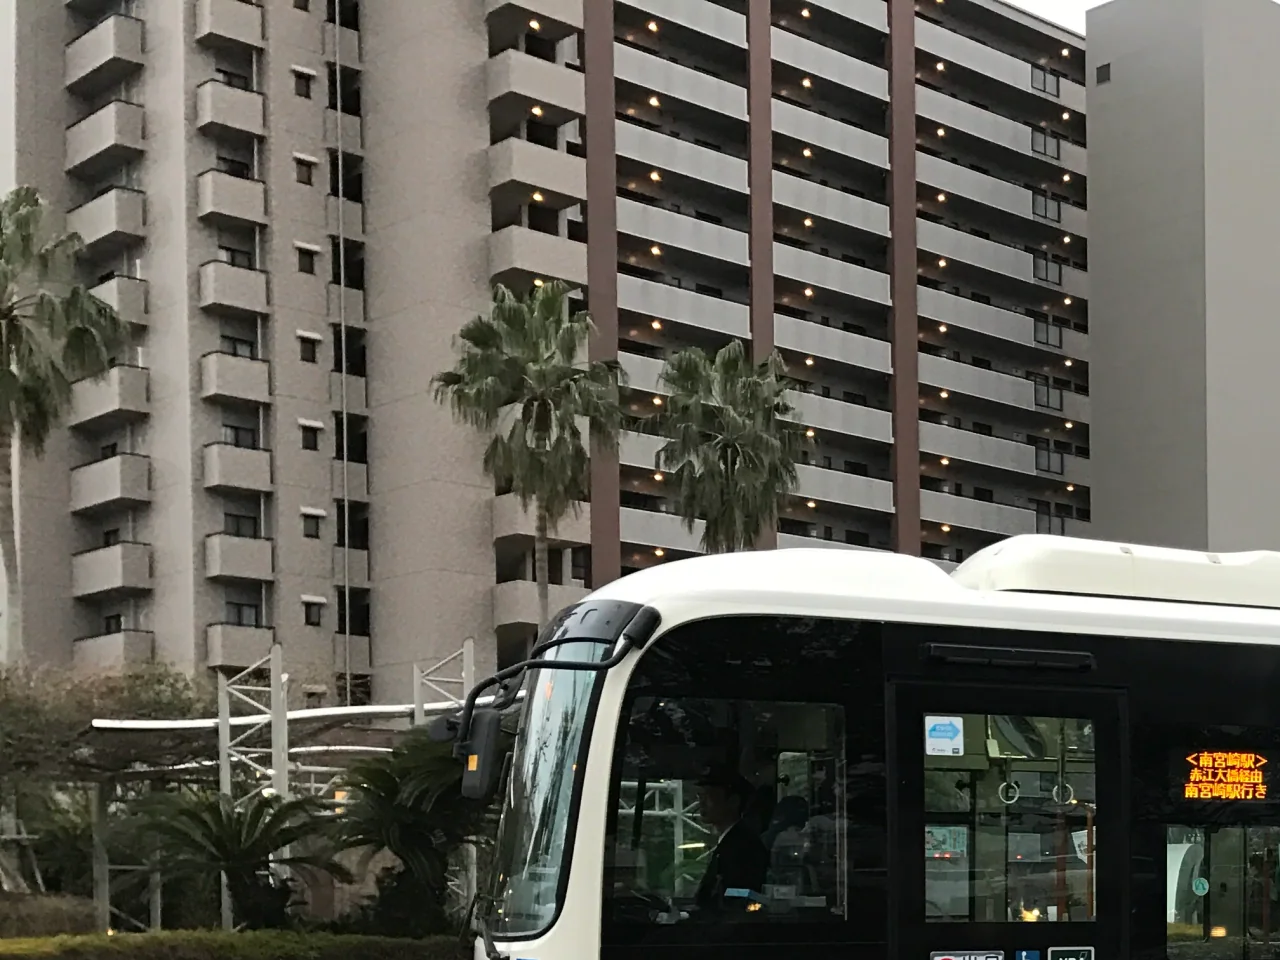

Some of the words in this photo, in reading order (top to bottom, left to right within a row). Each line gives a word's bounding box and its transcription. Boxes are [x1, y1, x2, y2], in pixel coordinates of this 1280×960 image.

[1189, 767, 1263, 783] 赤江大橋経由
[1184, 782, 1267, 799] 南宮崎駅行き
